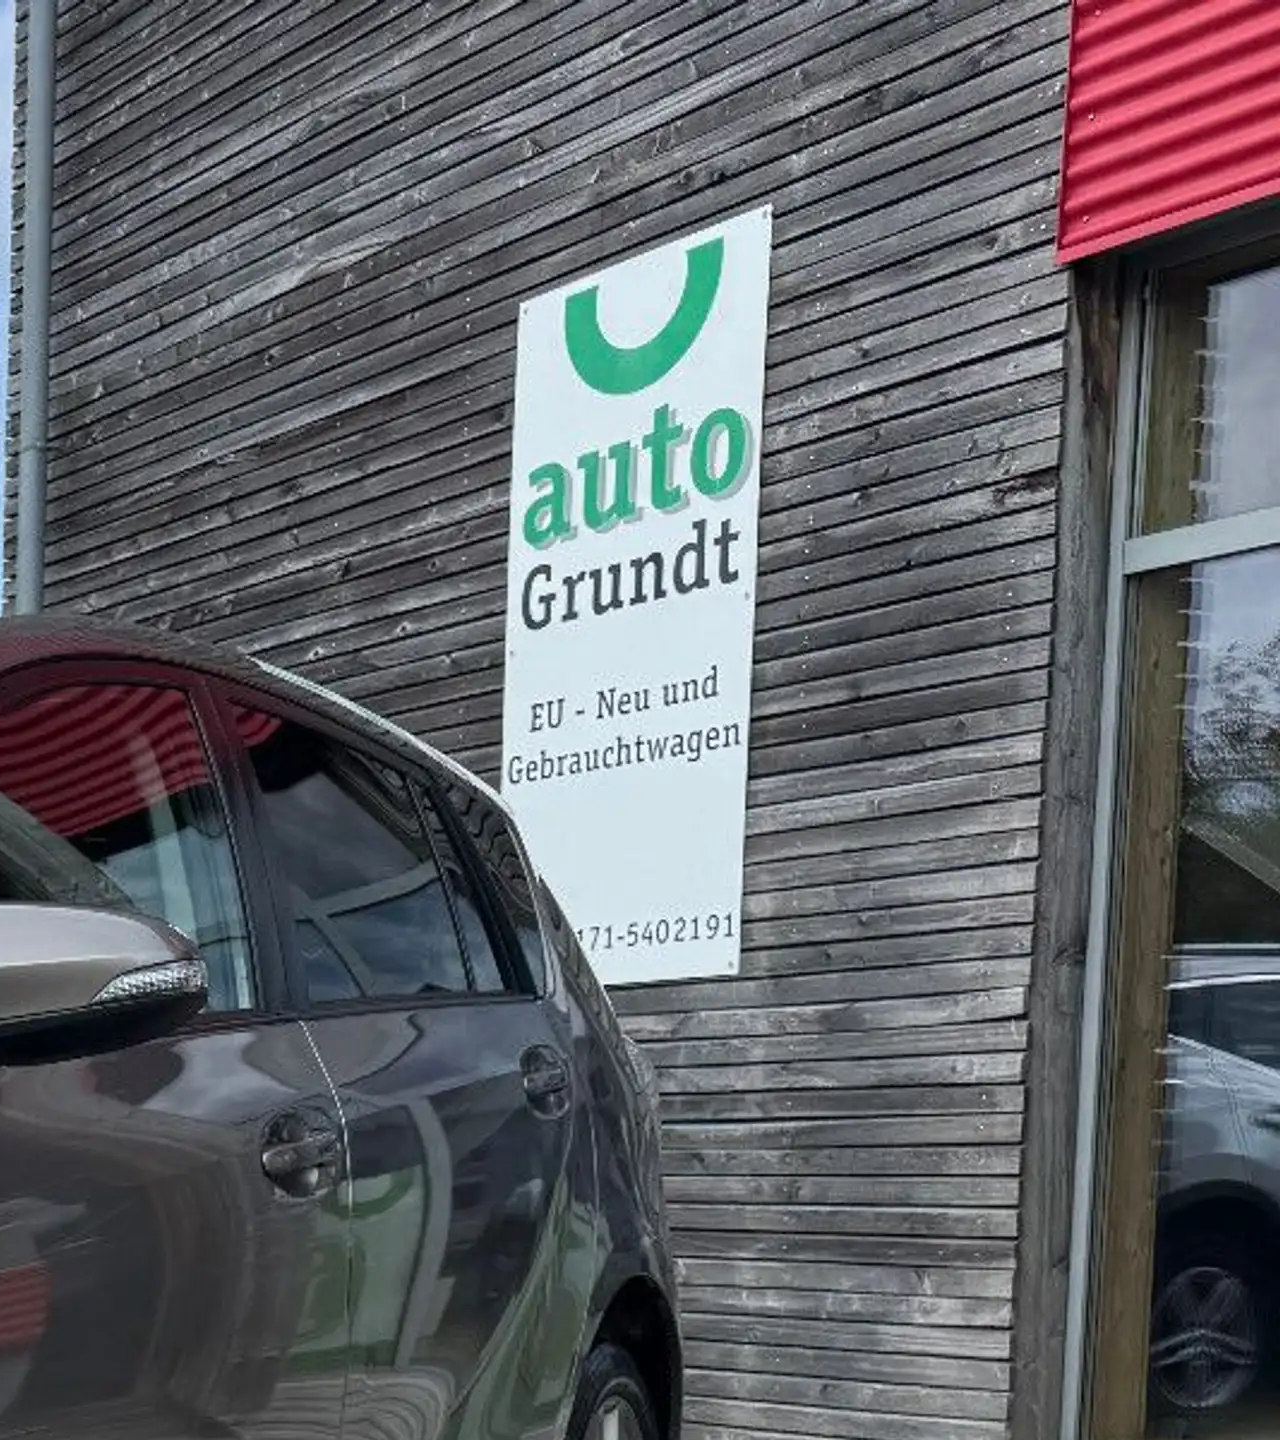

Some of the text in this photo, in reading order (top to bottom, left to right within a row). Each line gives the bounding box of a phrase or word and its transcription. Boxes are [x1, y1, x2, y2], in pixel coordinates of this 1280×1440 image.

[524, 403, 752, 550] auto
[521, 518, 740, 630] Grundt
[530, 699, 565, 733] EU
[596, 687, 650, 719] Neu
[663, 665, 719, 706] und
[508, 722, 741, 784] Gebrauchtwagen
